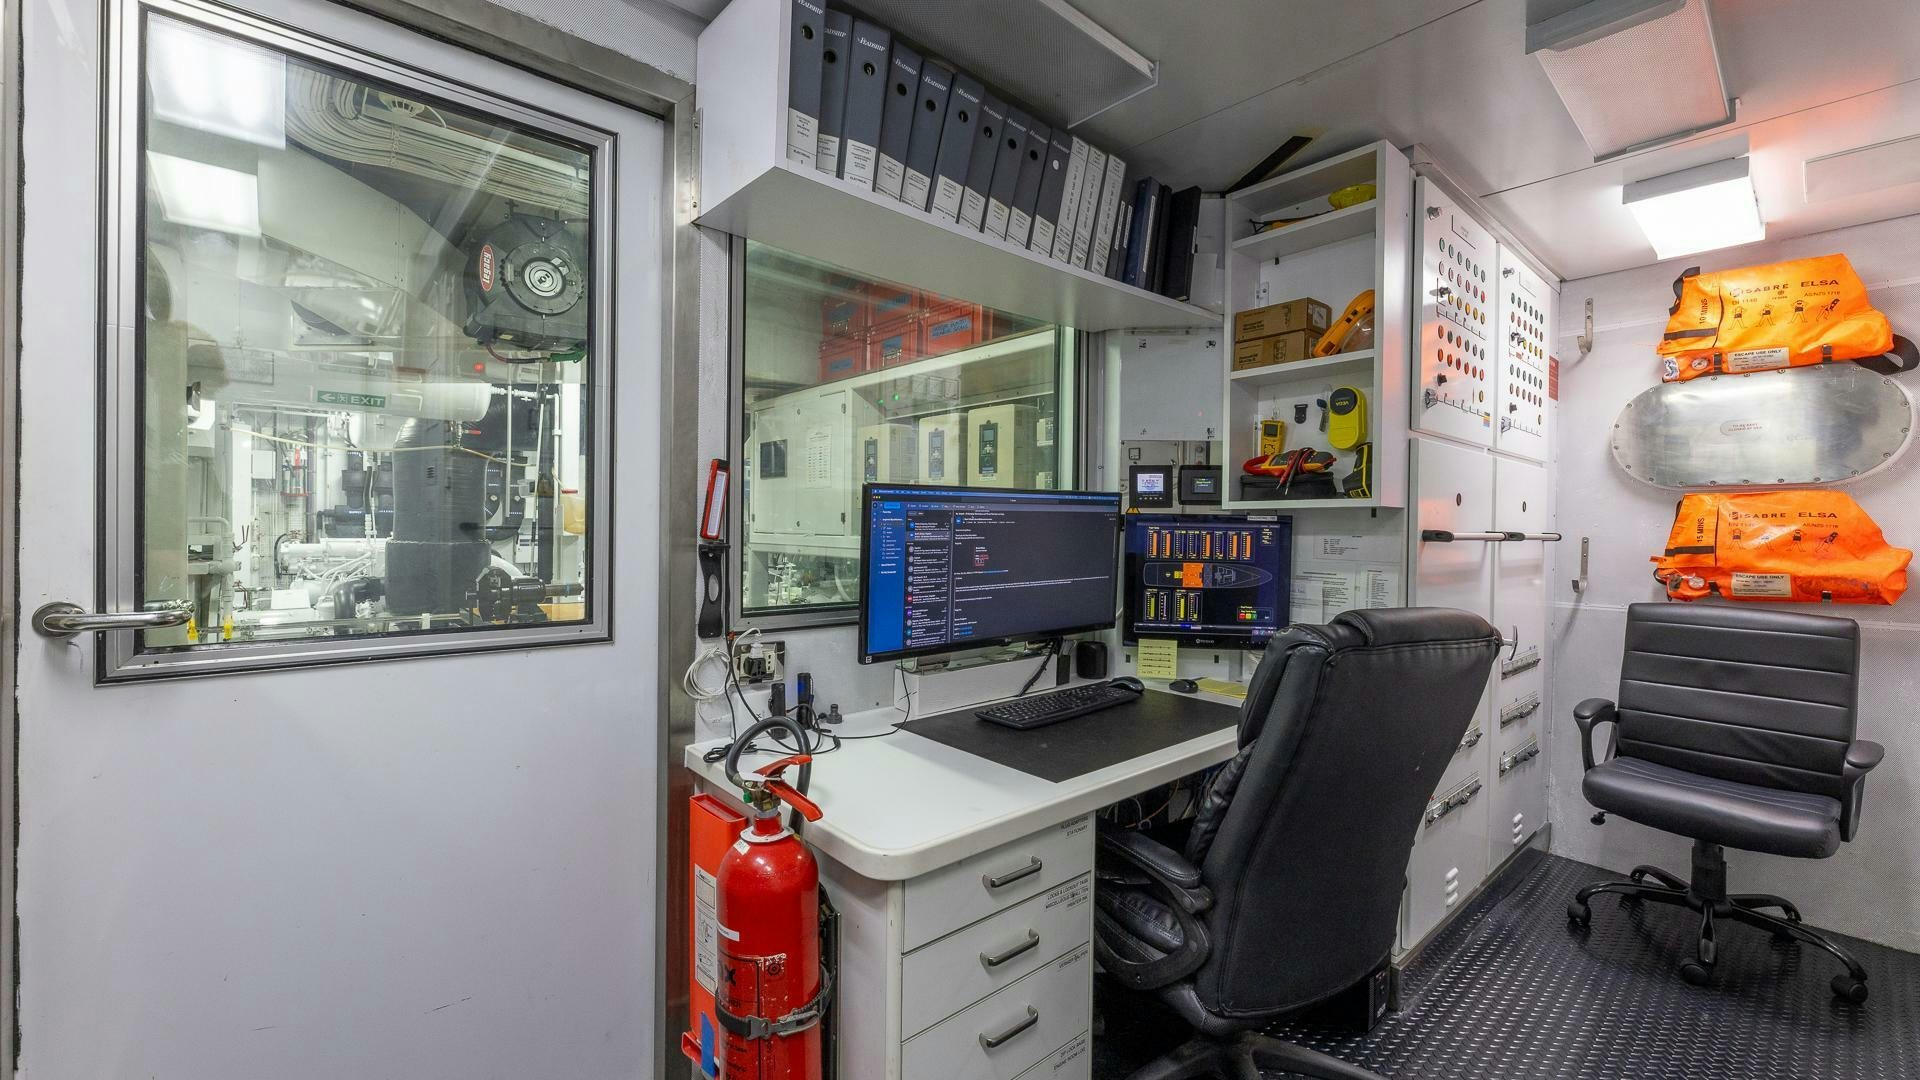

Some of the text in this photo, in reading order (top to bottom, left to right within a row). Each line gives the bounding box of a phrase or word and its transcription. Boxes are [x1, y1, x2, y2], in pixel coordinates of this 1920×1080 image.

[859, 37, 886, 52] FEADSHIP
[895, 58, 917, 75] FEADSHIP
[924, 76, 947, 91] FEADSHIP
[1745, 279, 1840, 294] SABRE ELSA
[1700, 298, 1708, 315] MINS
[350, 395, 384, 406] EXIT
[1798, 511, 1838, 519] ELSA
[1696, 517, 1704, 543] 15 MINS
